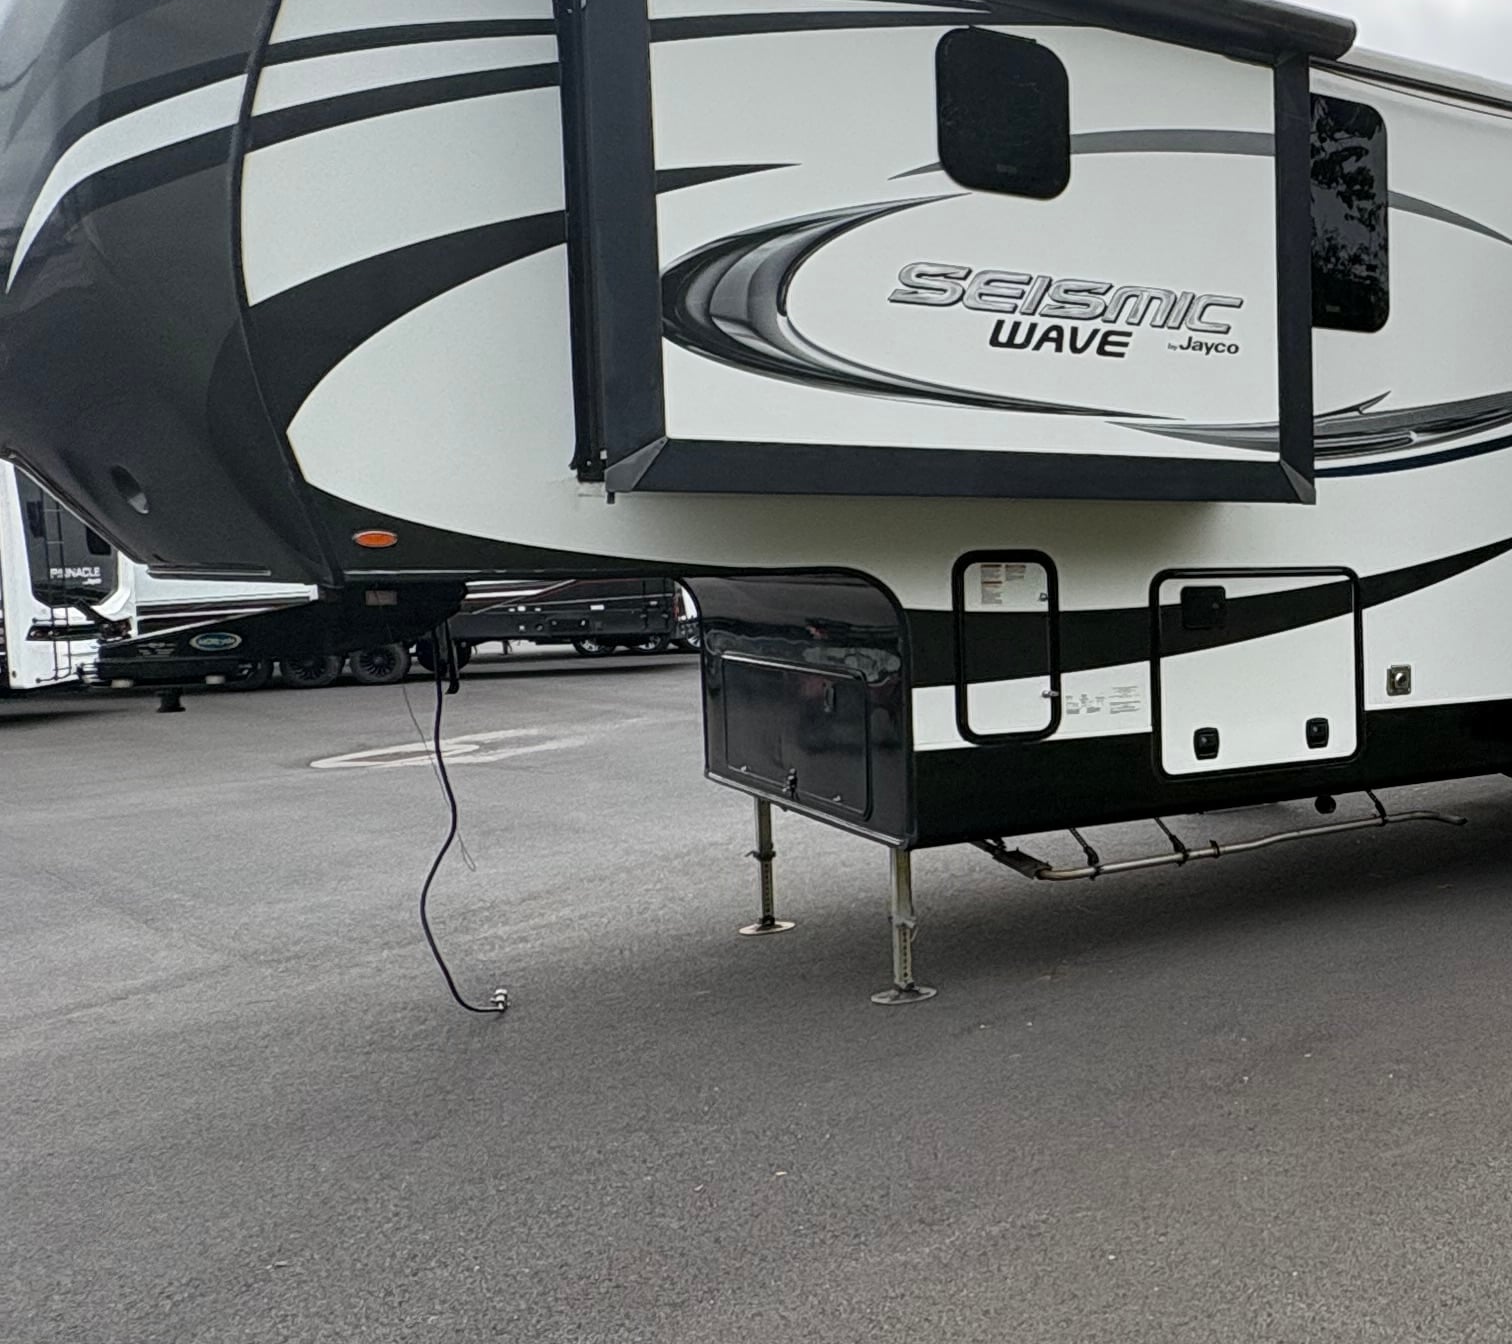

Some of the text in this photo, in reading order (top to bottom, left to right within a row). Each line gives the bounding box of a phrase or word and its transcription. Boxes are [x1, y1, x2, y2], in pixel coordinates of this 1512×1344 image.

[888, 262, 1243, 334] SEISMIC
[989, 319, 1136, 358] WAVE
[1179, 336, 1239, 356] Jayco
